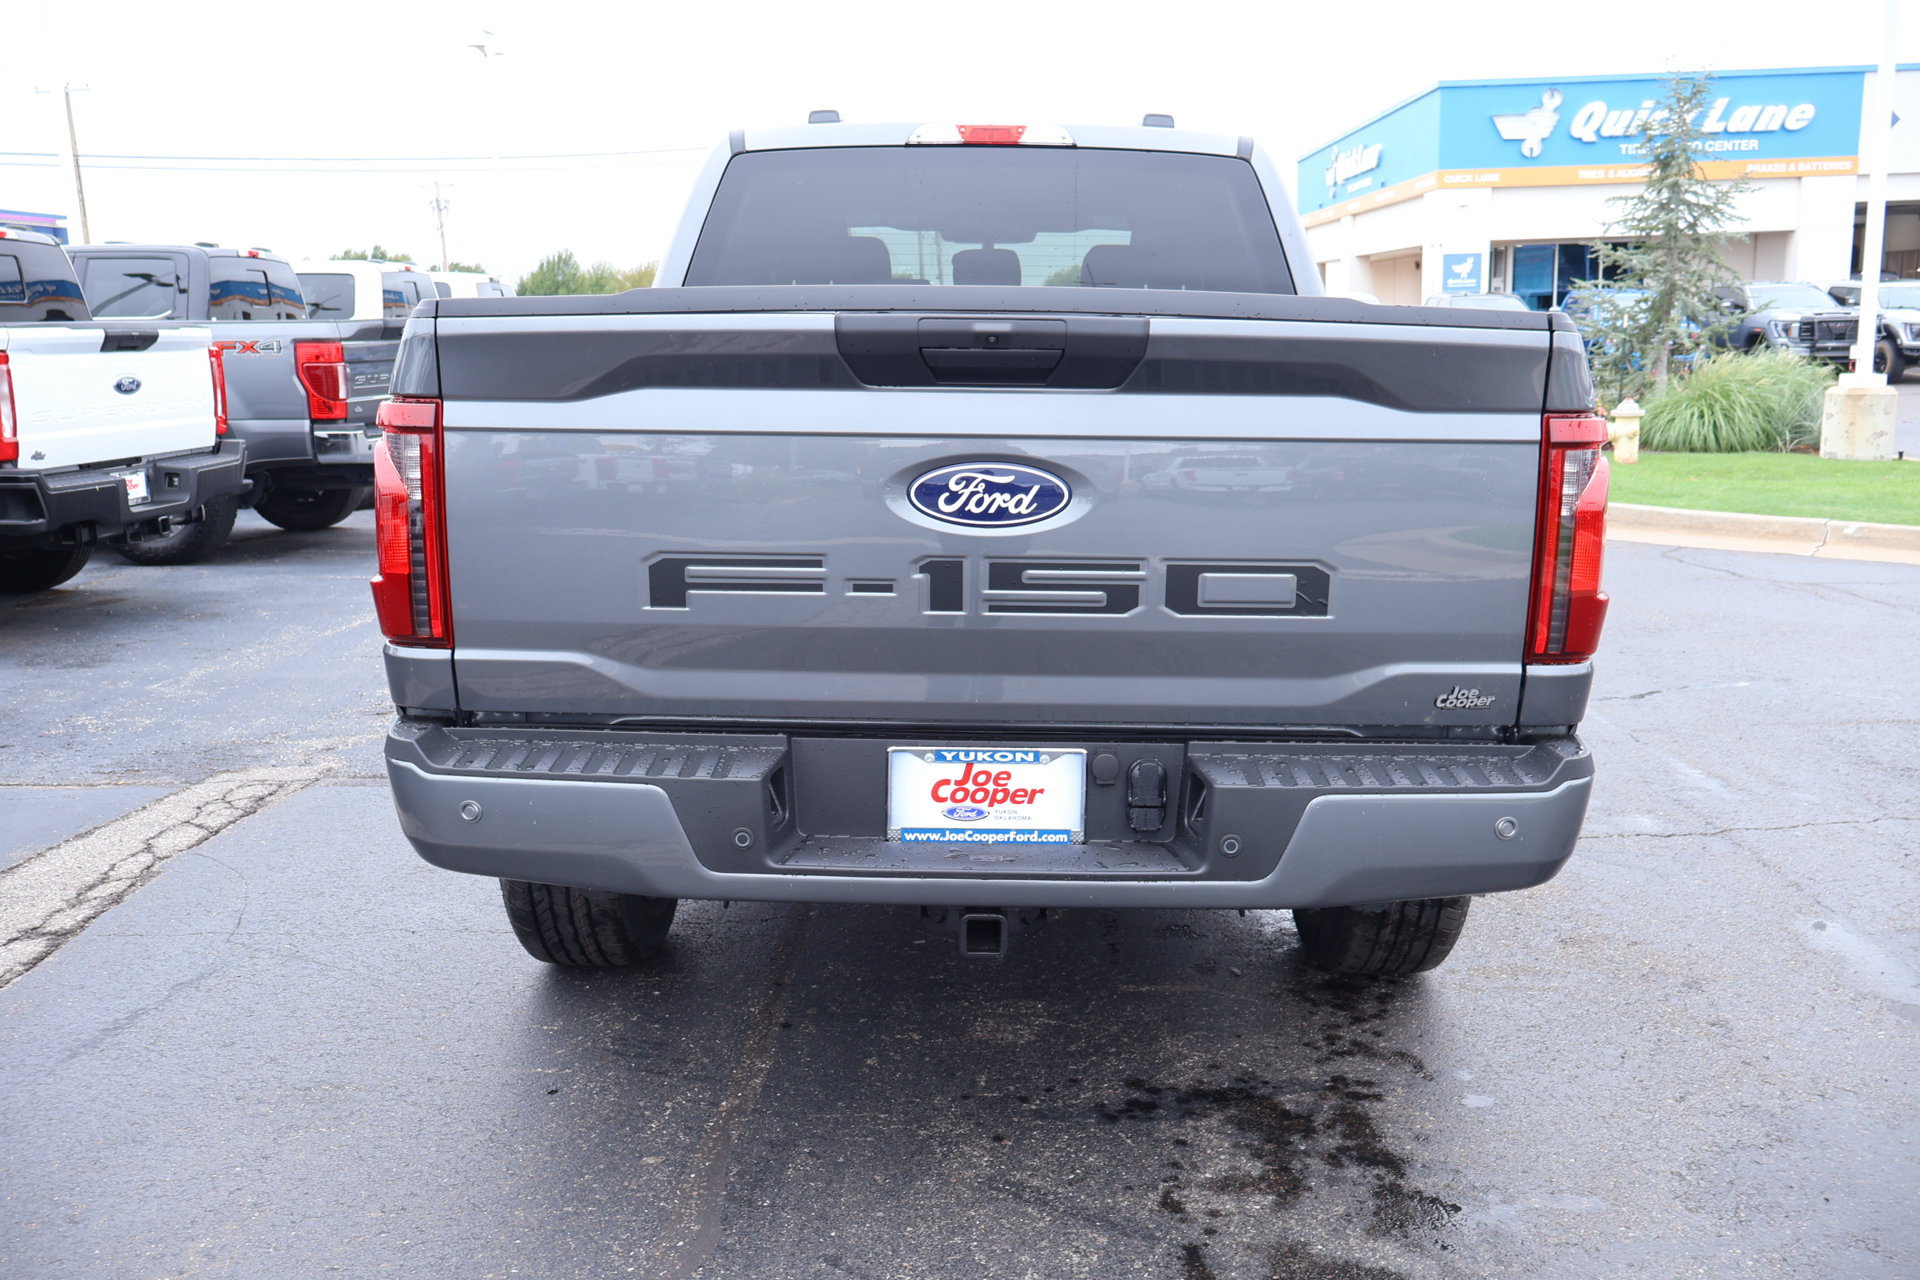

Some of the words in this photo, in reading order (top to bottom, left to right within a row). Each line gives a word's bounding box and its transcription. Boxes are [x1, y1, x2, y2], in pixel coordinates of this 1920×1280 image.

[1702, 97, 1816, 133] Lane
[1705, 139, 1759, 151] CENTER
[1444, 174, 1473, 184] QUICK
[1475, 173, 1501, 182] LUBE
[1577, 169, 1605, 179] TIRES
[1746, 163, 1787, 173] BRAKES
[1798, 161, 1853, 171] BATTERIES
[212, 340, 283, 355] FX4
[936, 472, 1037, 517] Ford
[646, 554, 1333, 618] F-150
[1436, 694, 1496, 708] Cooper
[1448, 686, 1479, 699] Joe
[940, 751, 1034, 762] YUKON
[954, 763, 1012, 787] Joe
[931, 778, 1045, 807] Cooper
[904, 831, 1068, 844] www.JoeCooperFord.com
